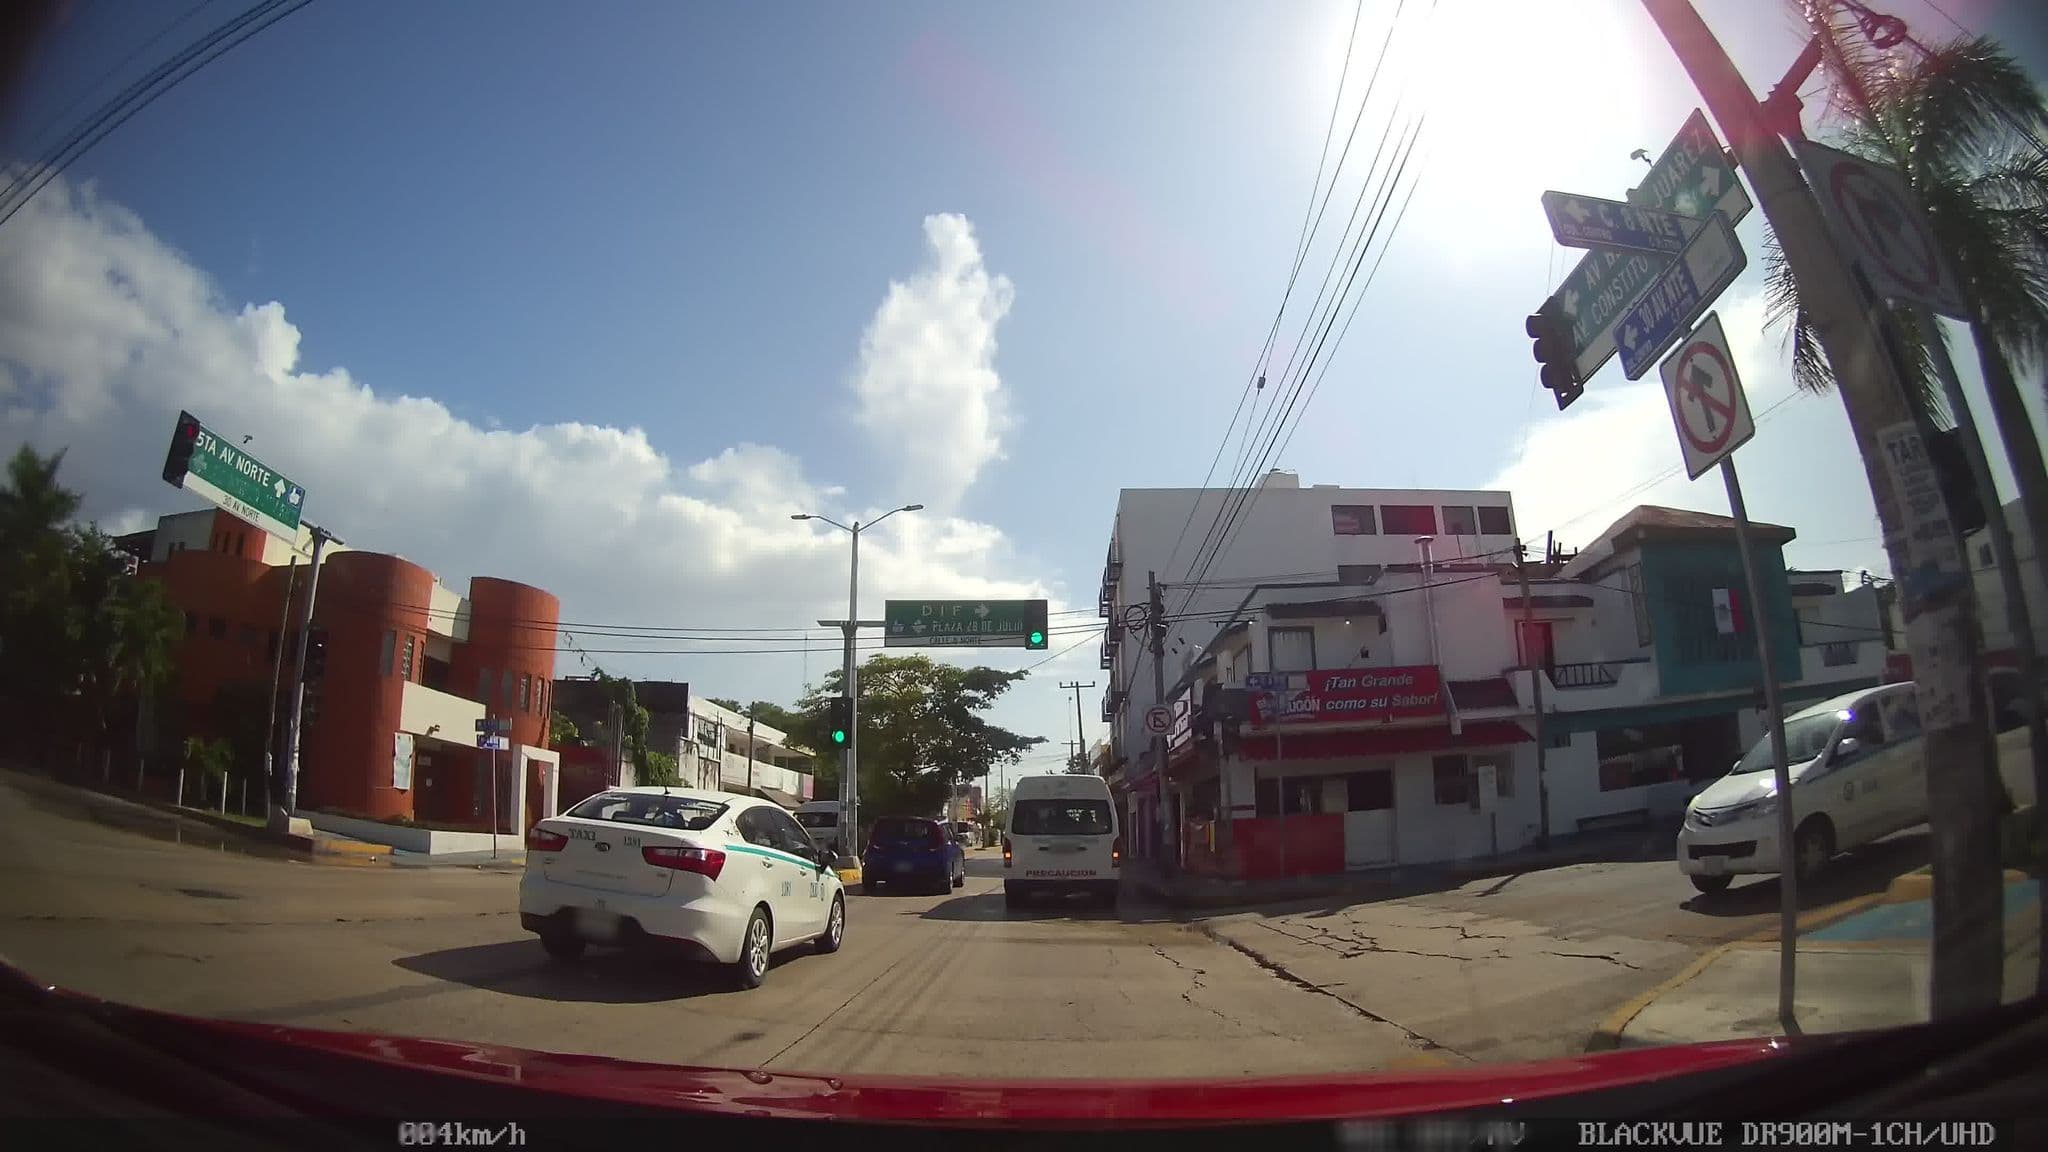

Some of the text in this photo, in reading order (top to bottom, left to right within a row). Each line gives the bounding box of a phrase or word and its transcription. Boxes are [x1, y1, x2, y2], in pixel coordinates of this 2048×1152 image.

[1591, 255, 1649, 324] CONSTITU
[195, 432, 216, 455] 5TA
[236, 455, 271, 487] NORTE
[242, 505, 260, 522] NORTE
[932, 620, 963, 633] PLAZA
[981, 619, 993, 632] DE
[997, 618, 1024, 632] JULIO
[1324, 673, 1415, 692] ¡Tan Grande
[1325, 698, 1367, 711] como
[1370, 696, 1389, 708] su
[1391, 690, 1440, 707] Sabor!
[568, 828, 596, 841] TAXI
[1025, 869, 1098, 877] PRECAUCION
